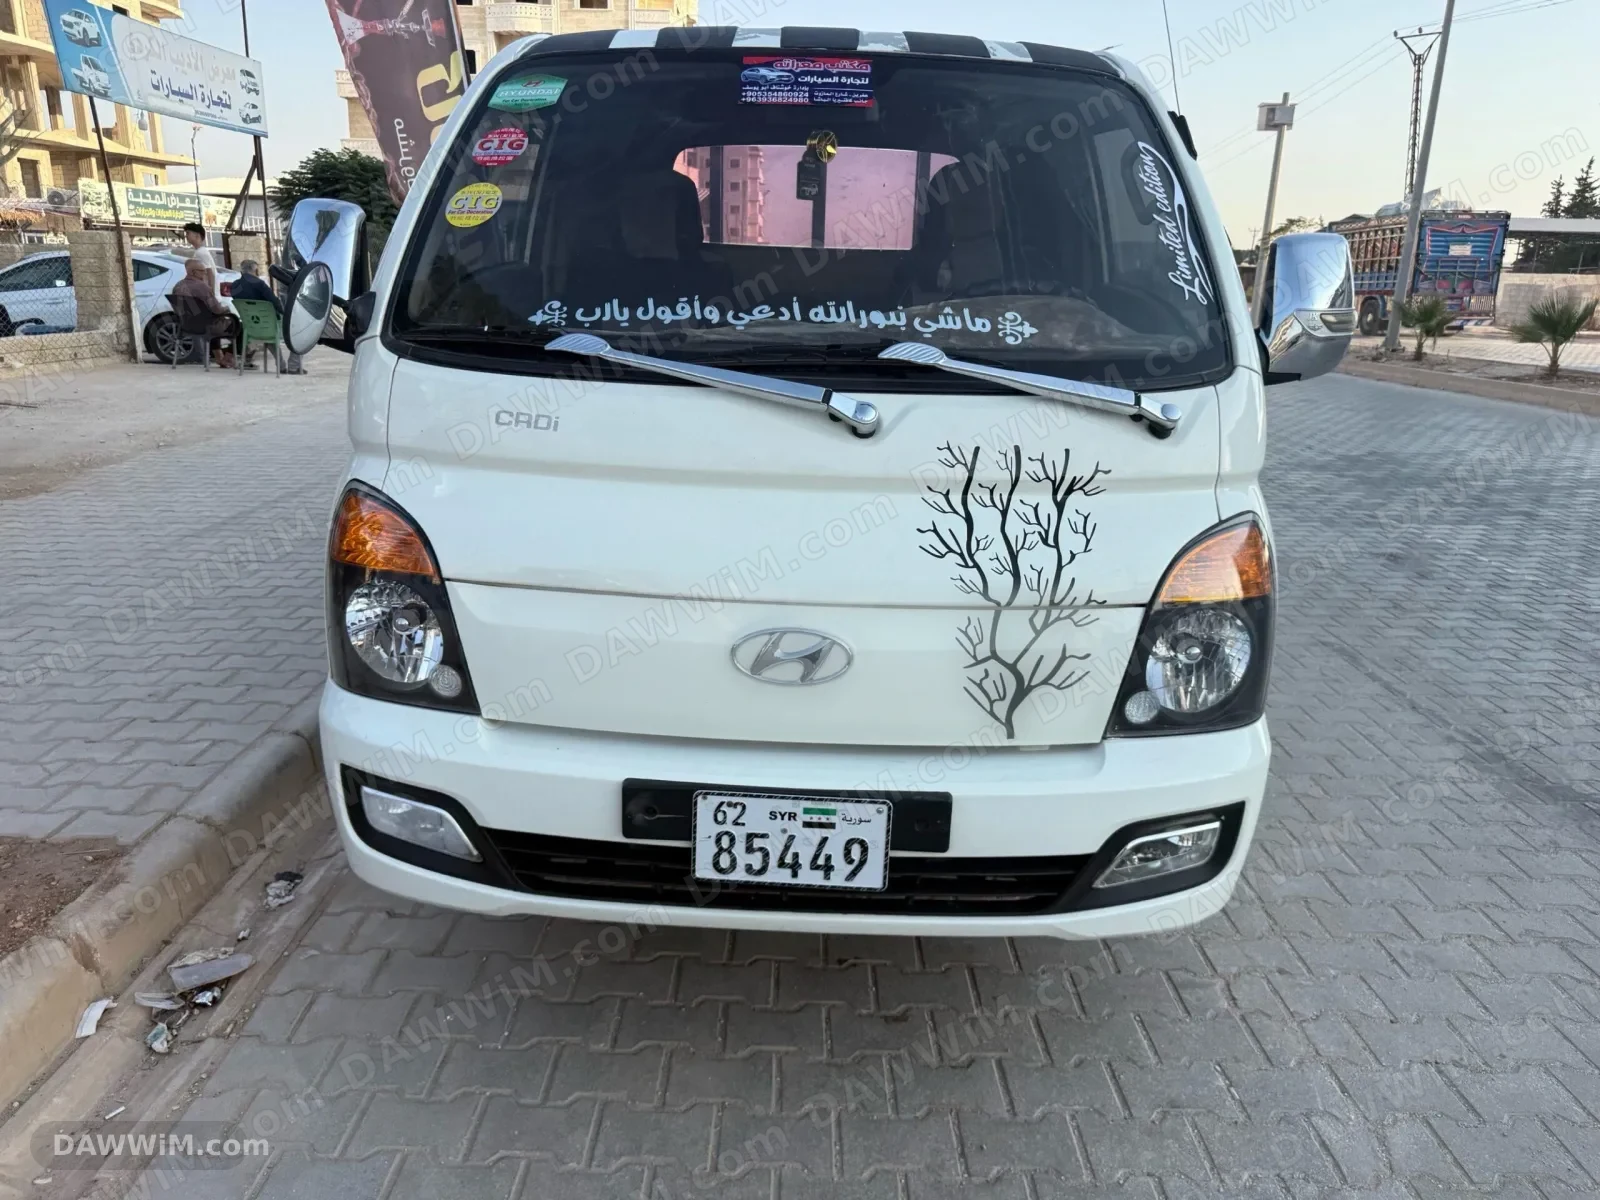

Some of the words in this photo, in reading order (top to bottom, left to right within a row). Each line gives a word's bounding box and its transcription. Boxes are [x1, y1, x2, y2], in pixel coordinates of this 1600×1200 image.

[797, 75, 839, 84] السيارات
[825, 59, 872, 73] مكتب
[840, 75, 869, 85] لتجارة
[150, 69, 198, 104] السيارات
[198, 83, 232, 113] لتجارة
[499, 88, 559, 97] HYUNDAI
[478, 138, 526, 151] CIG
[1137, 141, 1173, 213] edition
[451, 195, 500, 209] CIG
[1152, 214, 1208, 305] Limited
[636, 295, 721, 324] وأقول
[726, 296, 802, 330] أدعي
[913, 306, 992, 338] ماشي
[713, 800, 747, 827] 62
[769, 810, 798, 822] SYR
[841, 813, 872, 825] سورية
[712, 830, 870, 882] 85449
